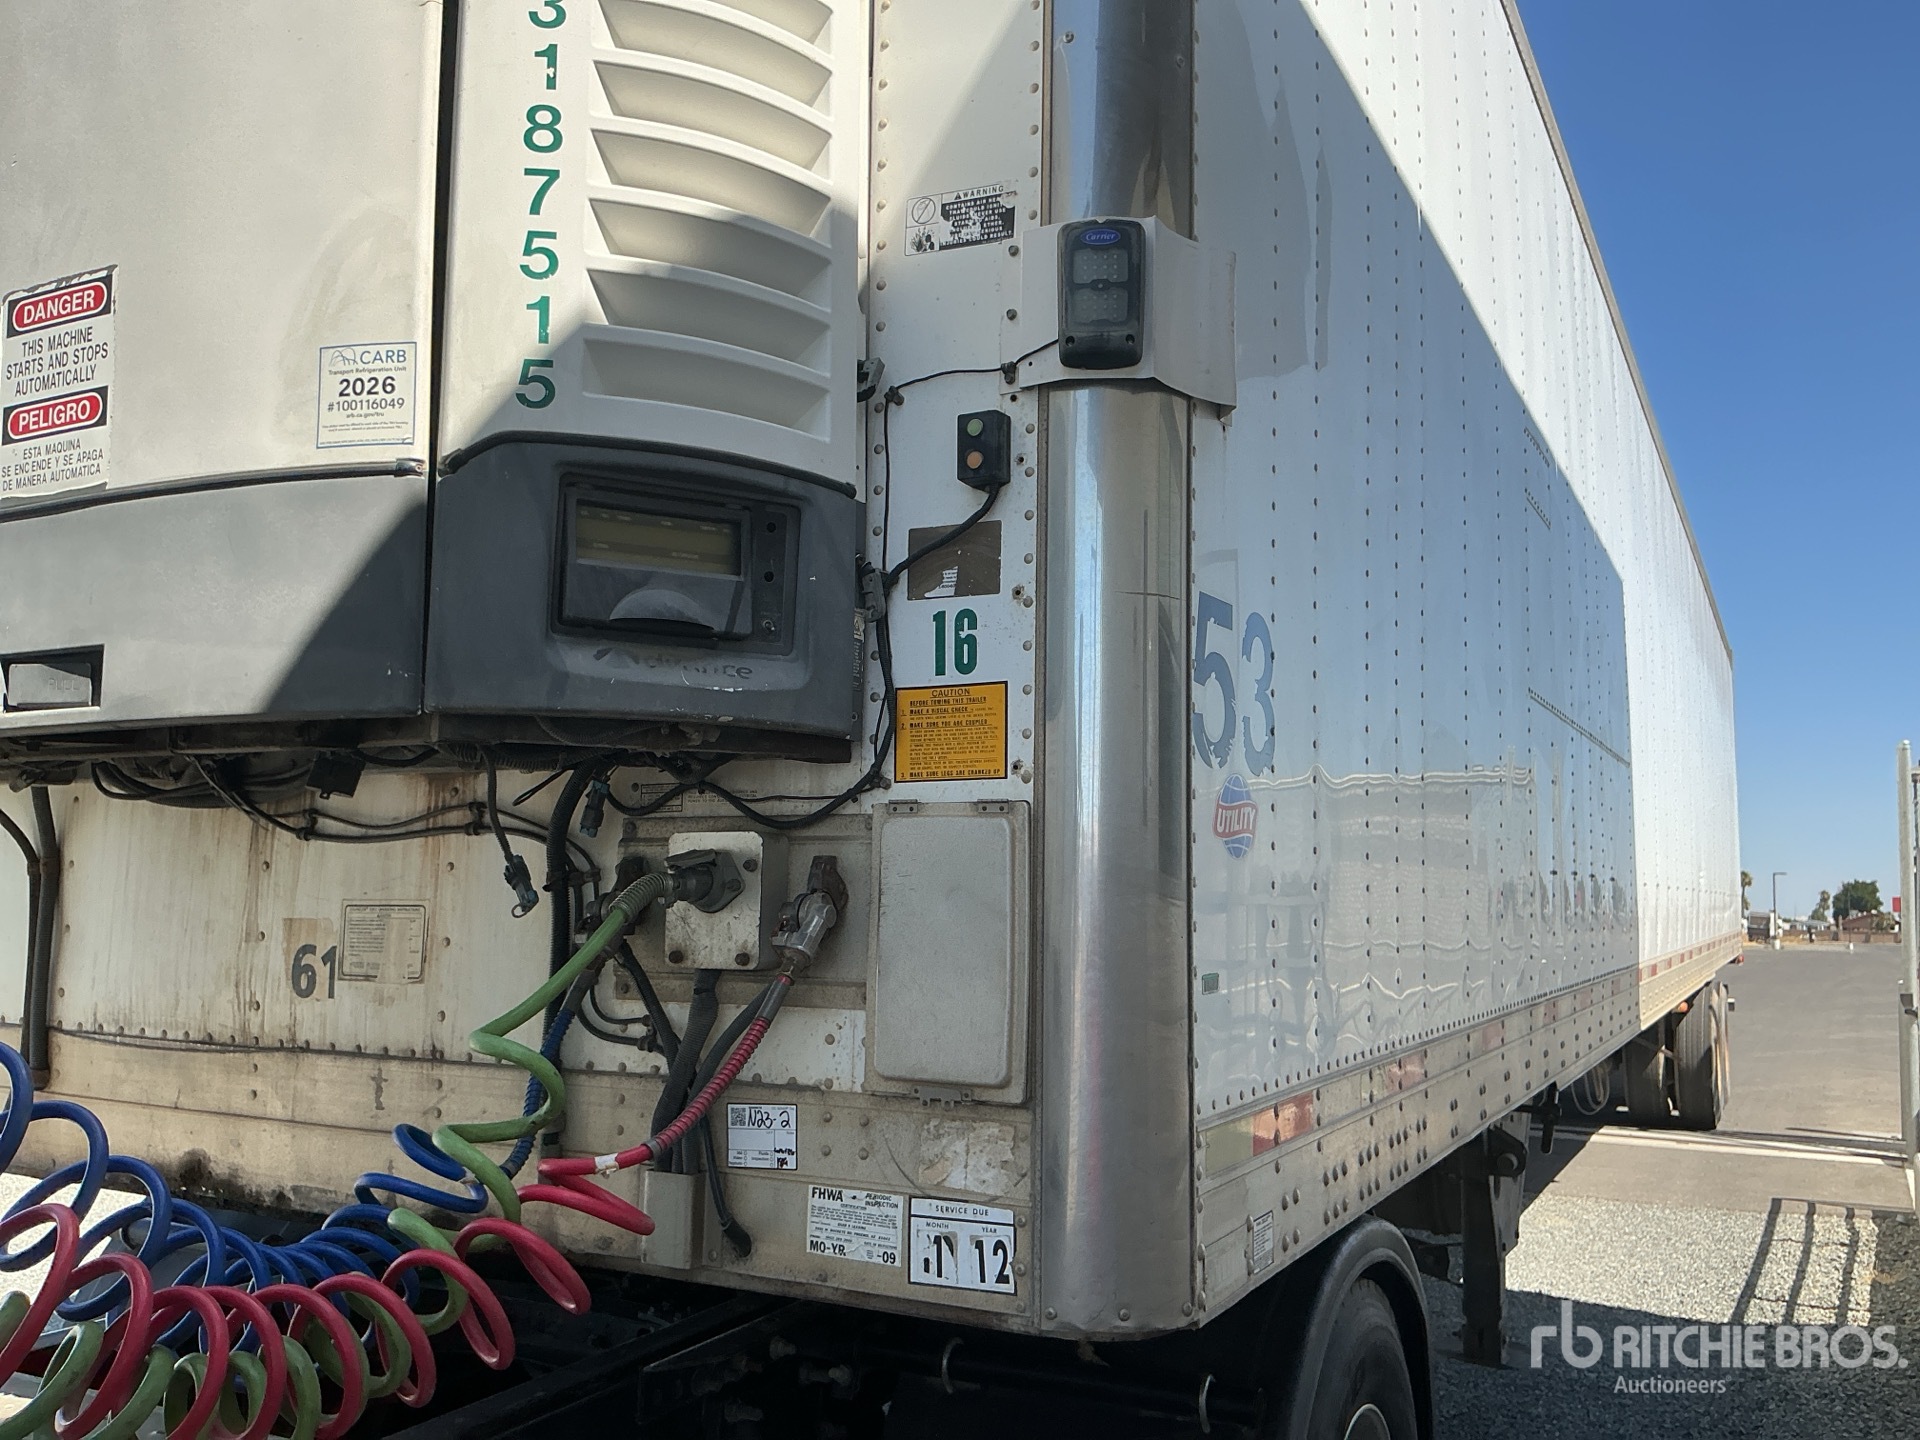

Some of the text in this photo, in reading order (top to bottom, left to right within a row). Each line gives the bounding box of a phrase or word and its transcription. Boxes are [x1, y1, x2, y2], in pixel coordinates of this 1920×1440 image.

[963, 185, 1004, 199] WARNING
[1085, 231, 1116, 241] Carrier
[23, 289, 95, 325] DANGER
[22, 326, 93, 358] THIS MACHINE
[6, 342, 109, 380] STARTS AND STOPS
[360, 349, 407, 365] CARB
[15, 364, 97, 397] AUTOMATICALLY
[355, 367, 393, 375] Refrigeration
[338, 375, 396, 398] 2026
[18, 399, 91, 433] PELIGRO
[327, 397, 405, 412] #100116049
[23, 438, 81, 460] ESTA MAQUINA
[1, 465, 11, 478] SE
[54, 456, 61, 468] Y
[63, 453, 74, 467] SE
[76, 448, 104, 464] APAGA
[2, 463, 101, 491] DE MANERA AUTOMATICA
[932, 608, 978, 676] 16
[931, 688, 971, 697] CAUTION
[1193, 591, 1275, 776] 53
[1216, 807, 1256, 833] UTILITY
[291, 944, 338, 1000] 61
[811, 1186, 892, 1202] FHWA PERIODIC
[864, 1201, 899, 1209] INSPECTION
[935, 1204, 989, 1217] SERVICE DUE
[925, 1221, 997, 1234] MONTH YEAR
[974, 1239, 1010, 1285] 12
